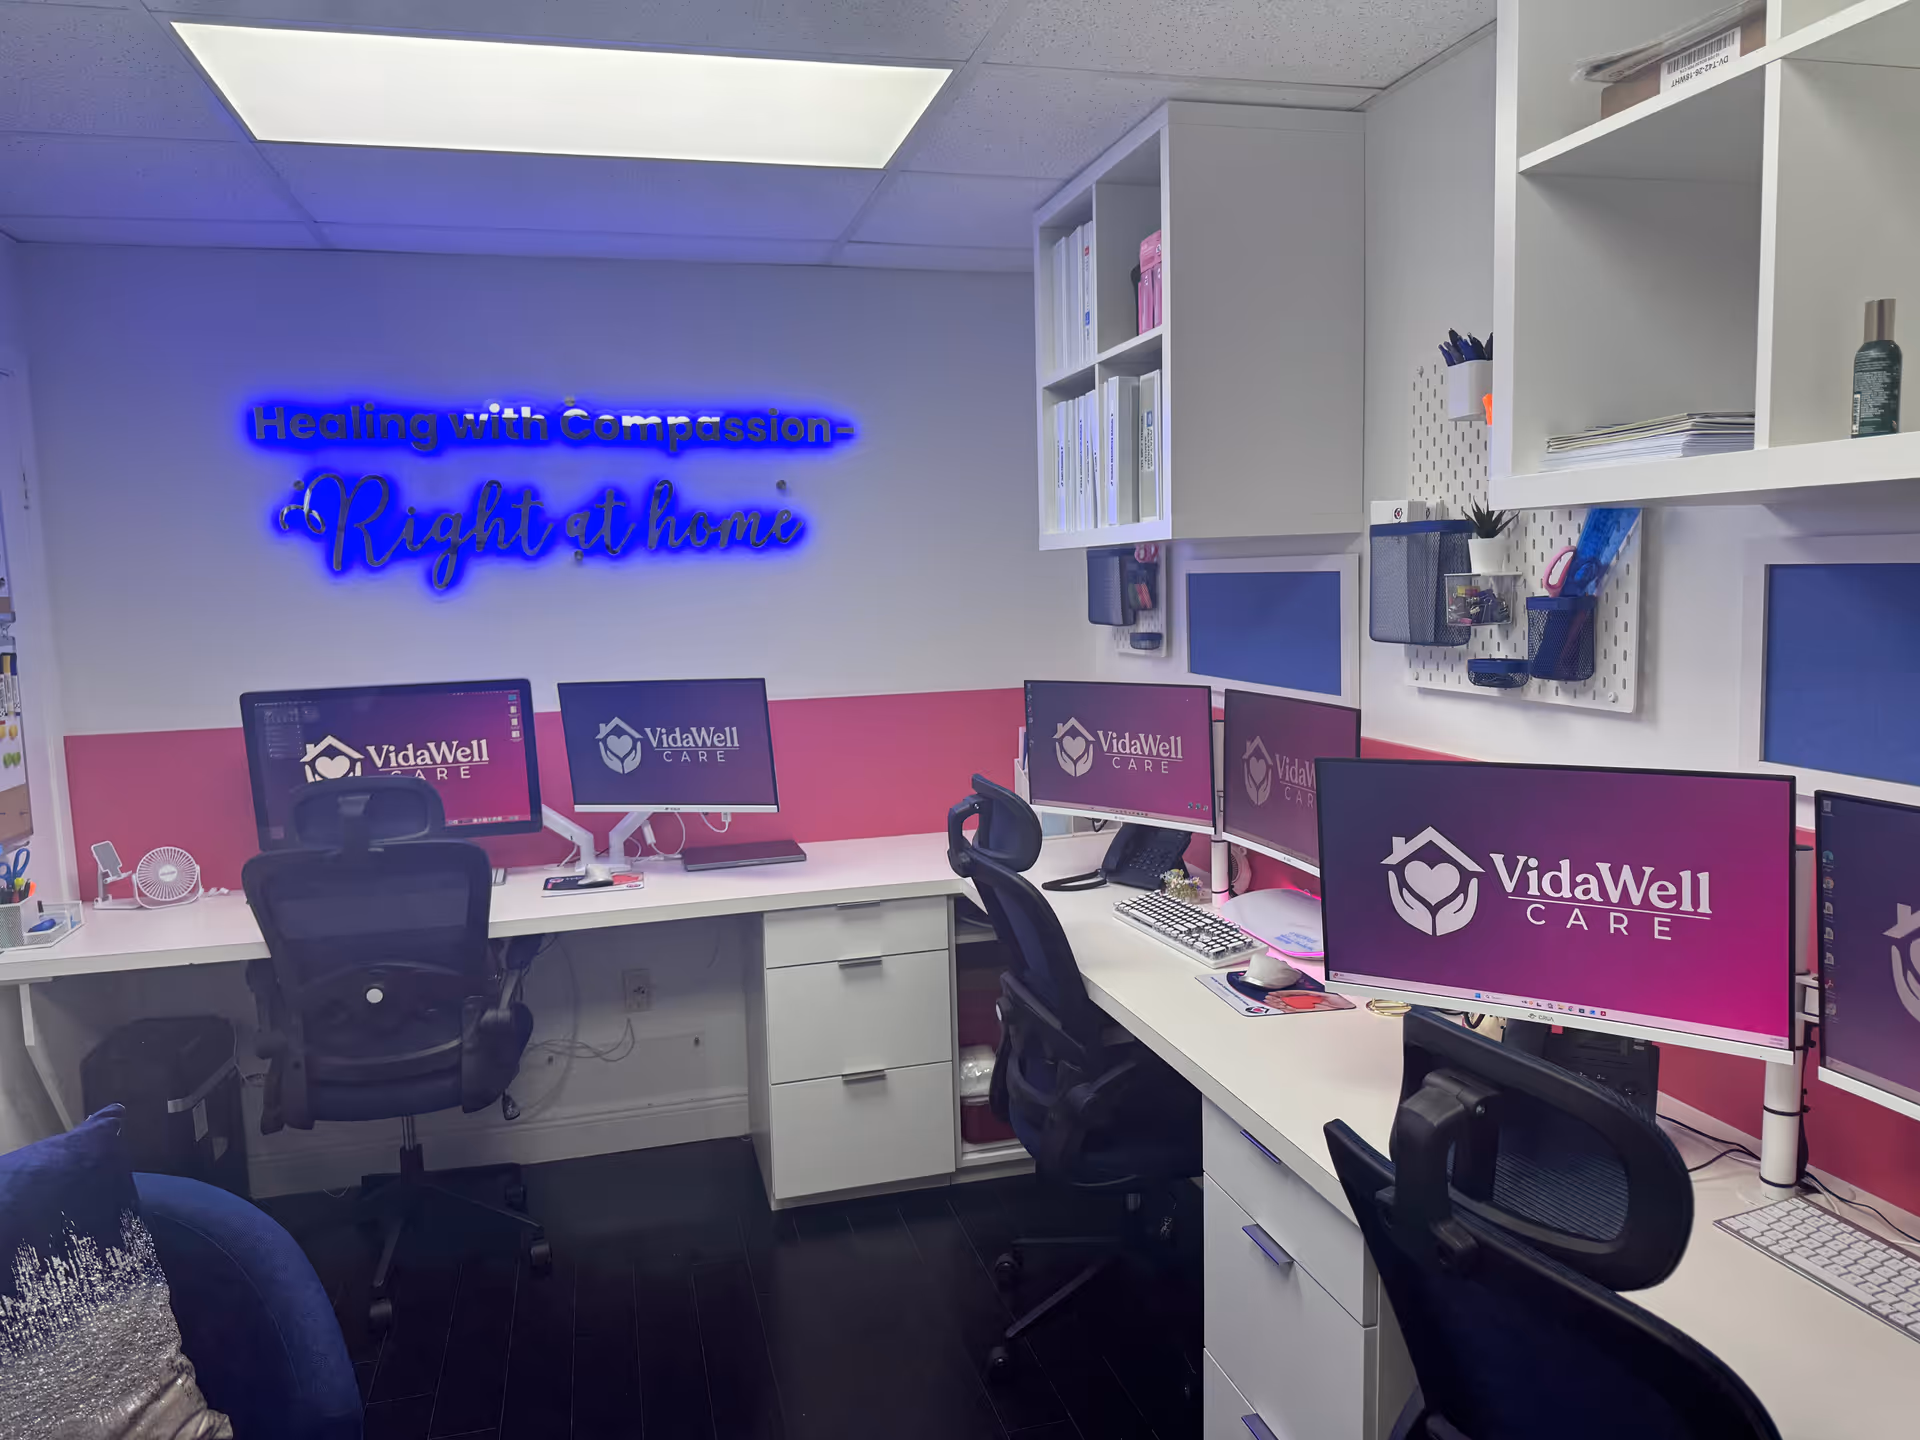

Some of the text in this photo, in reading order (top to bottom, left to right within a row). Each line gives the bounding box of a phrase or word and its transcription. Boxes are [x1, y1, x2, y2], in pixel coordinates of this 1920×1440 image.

[253, 403, 438, 451] Healing
[455, 403, 549, 441] with
[279, 473, 806, 589] Right at home
[643, 726, 739, 750] VidaWell
[1097, 730, 1183, 759] VidaWell
[366, 739, 489, 768] VidaWell
[662, 750, 726, 763] CARE
[1112, 757, 1169, 774] CARE
[1488, 852, 1713, 915] VidaWell
[1526, 903, 1673, 941] CARE
